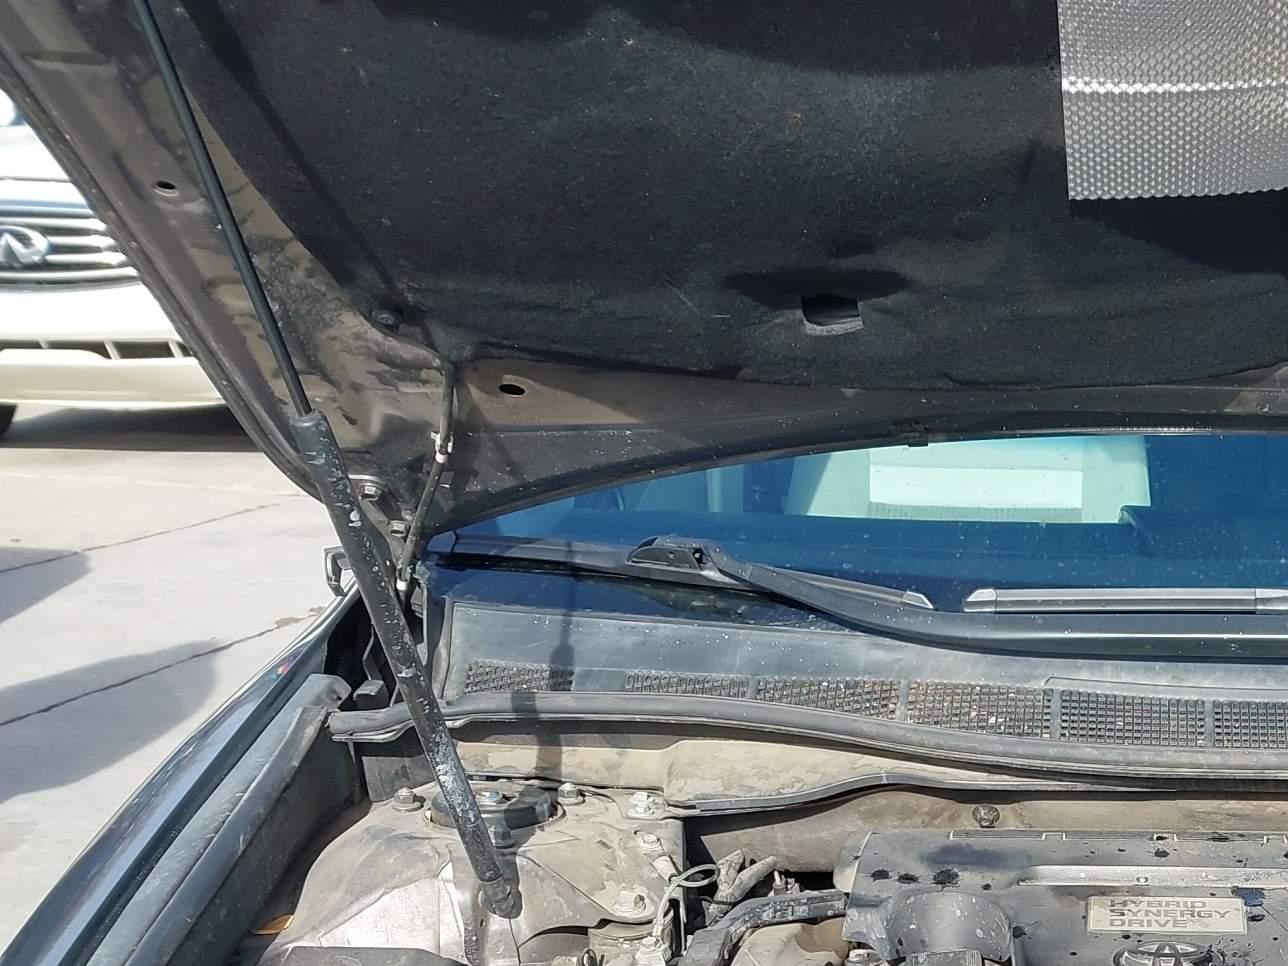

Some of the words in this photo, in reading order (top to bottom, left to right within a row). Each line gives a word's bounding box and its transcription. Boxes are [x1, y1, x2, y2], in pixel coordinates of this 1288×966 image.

[1109, 899, 1207, 909] HYBRID
[1109, 908, 1231, 919] SYNERGY
[1109, 918, 1189, 928] DRIVE
